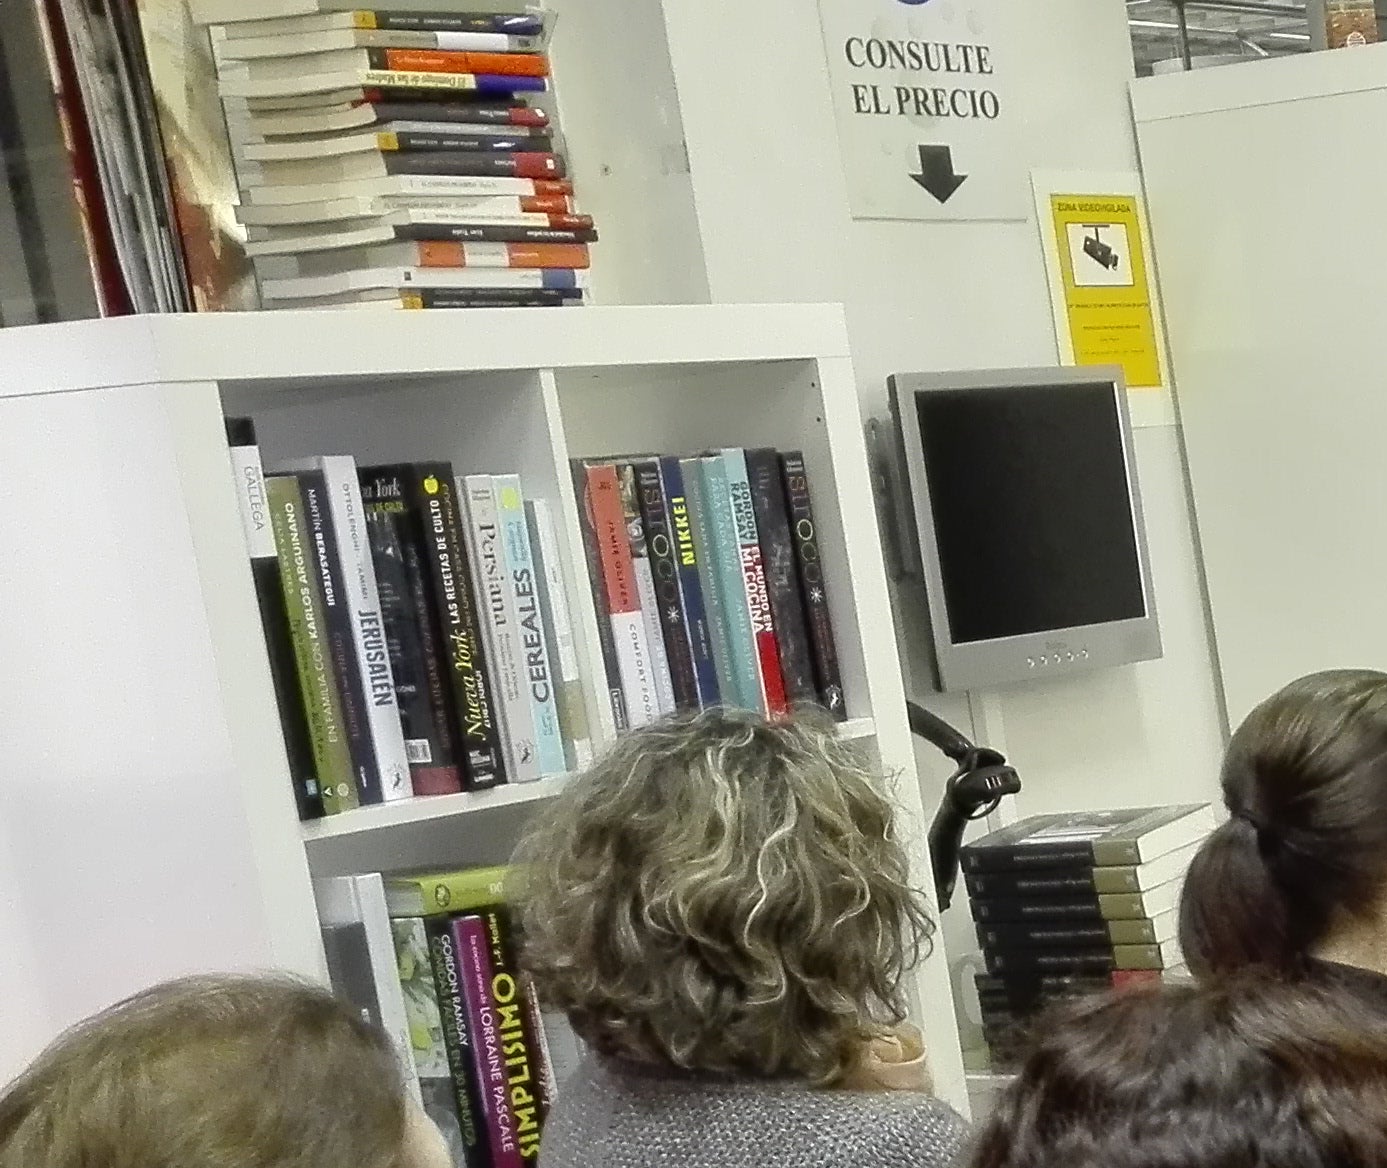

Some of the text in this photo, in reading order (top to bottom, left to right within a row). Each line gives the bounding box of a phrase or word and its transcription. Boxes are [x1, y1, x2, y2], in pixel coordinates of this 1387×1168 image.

[845, 37, 994, 75] CONSULTE
[852, 84, 1000, 119] EL PRECIO
[1057, 202, 1077, 213] ZONA
[243, 465, 265, 532] GALLEGA
[428, 499, 445, 534] CULTO
[730, 482, 749, 543] RAMSAY
[739, 481, 757, 543] GORDON
[436, 536, 448, 551] DE
[671, 496, 697, 568] NIKKEI
[314, 526, 336, 607] BERASATEGUI
[440, 552, 458, 601] RECETAS
[479, 522, 507, 627] Persiana
[750, 546, 774, 633] EL MUNDO EN
[300, 588, 319, 641] KARLOS
[446, 601, 462, 625] LAS
[745, 571, 765, 634] COCINA
[512, 567, 548, 704] CEREALES
[629, 622, 647, 682] COMFORT
[439, 934, 470, 1048] GORDON RAMSAY
[479, 1006, 503, 1081] LORRAINE
[494, 1085, 516, 1152] PASCALE
[491, 972, 541, 1160] SIMPLISIMO
